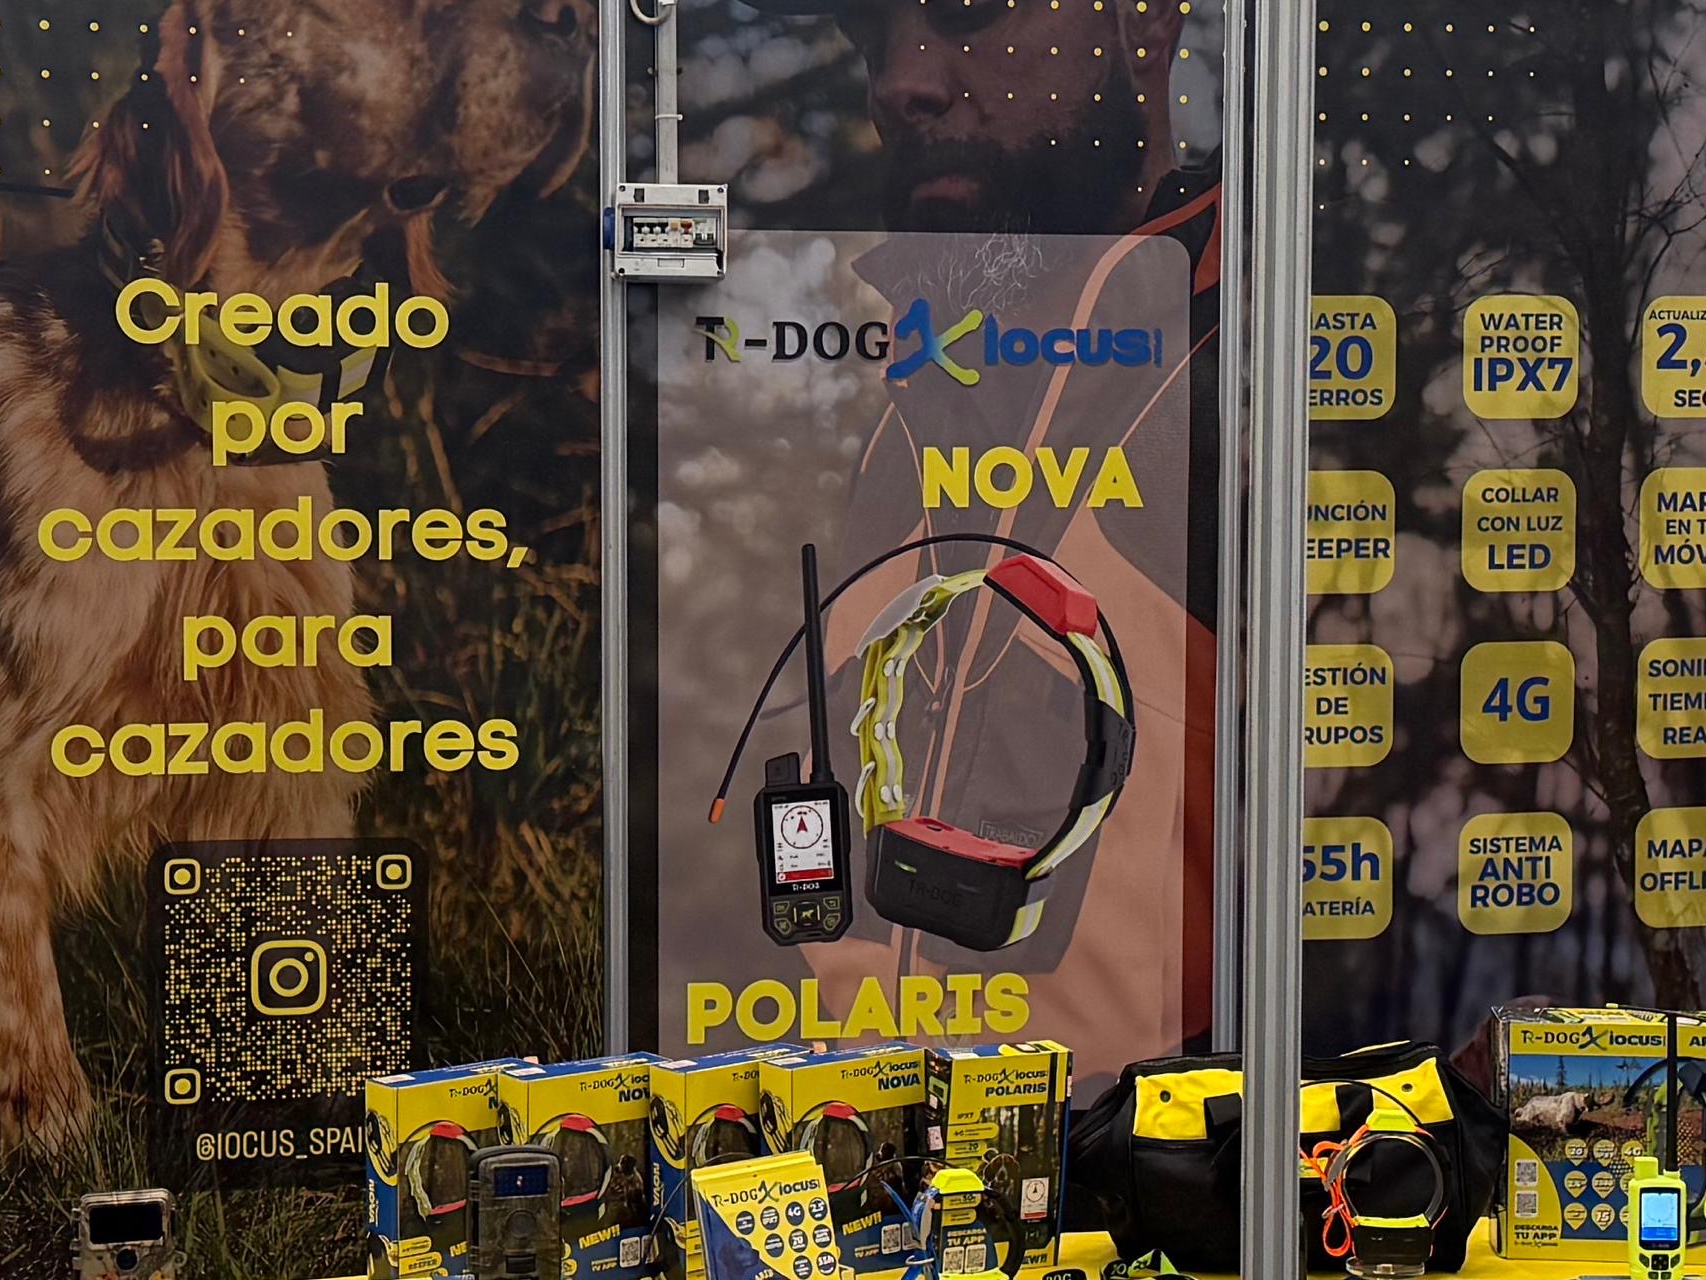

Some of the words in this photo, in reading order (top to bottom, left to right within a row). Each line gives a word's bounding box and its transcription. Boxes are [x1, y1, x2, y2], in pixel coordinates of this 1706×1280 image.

[115, 277, 450, 348] Creado
[1481, 313, 1563, 331] WATER
[1481, 335, 1561, 354] PROOF
[1309, 335, 1373, 380] 20
[1473, 357, 1573, 392] IPX7
[1308, 388, 1383, 406] ERROS
[211, 399, 364, 466] por
[922, 446, 1143, 509] NOVA
[1481, 488, 1559, 504] COLLAR
[1308, 500, 1387, 521] NCIÓN
[38, 495, 529, 569] cazadores,
[1477, 517, 1523, 533] CON
[1527, 516, 1563, 532] LUZ
[1666, 520, 1693, 535] EN
[1307, 538, 1391, 559] EEPER
[1488, 544, 1551, 570] LED
[183, 614, 392, 681] para
[1305, 663, 1386, 686] ESTIÓN
[1316, 697, 1349, 715] DE
[1482, 676, 1550, 723] 4G
[51, 708, 520, 779] cazadores
[1304, 726, 1384, 745] RUPOS
[1469, 835, 1562, 855] SISTEMA
[1478, 856, 1552, 882] ANTI
[1470, 883, 1560, 908] ROBO
[1303, 897, 1375, 917] ATERÍA
[686, 973, 1030, 1044] POLARIS
[878, 1075, 920, 1091] NOVA
[985, 1083, 1047, 1098] POLARIS
[196, 1126, 365, 1161] @IOCUS_SPAI
[1533, 1232, 1557, 1240] APP
